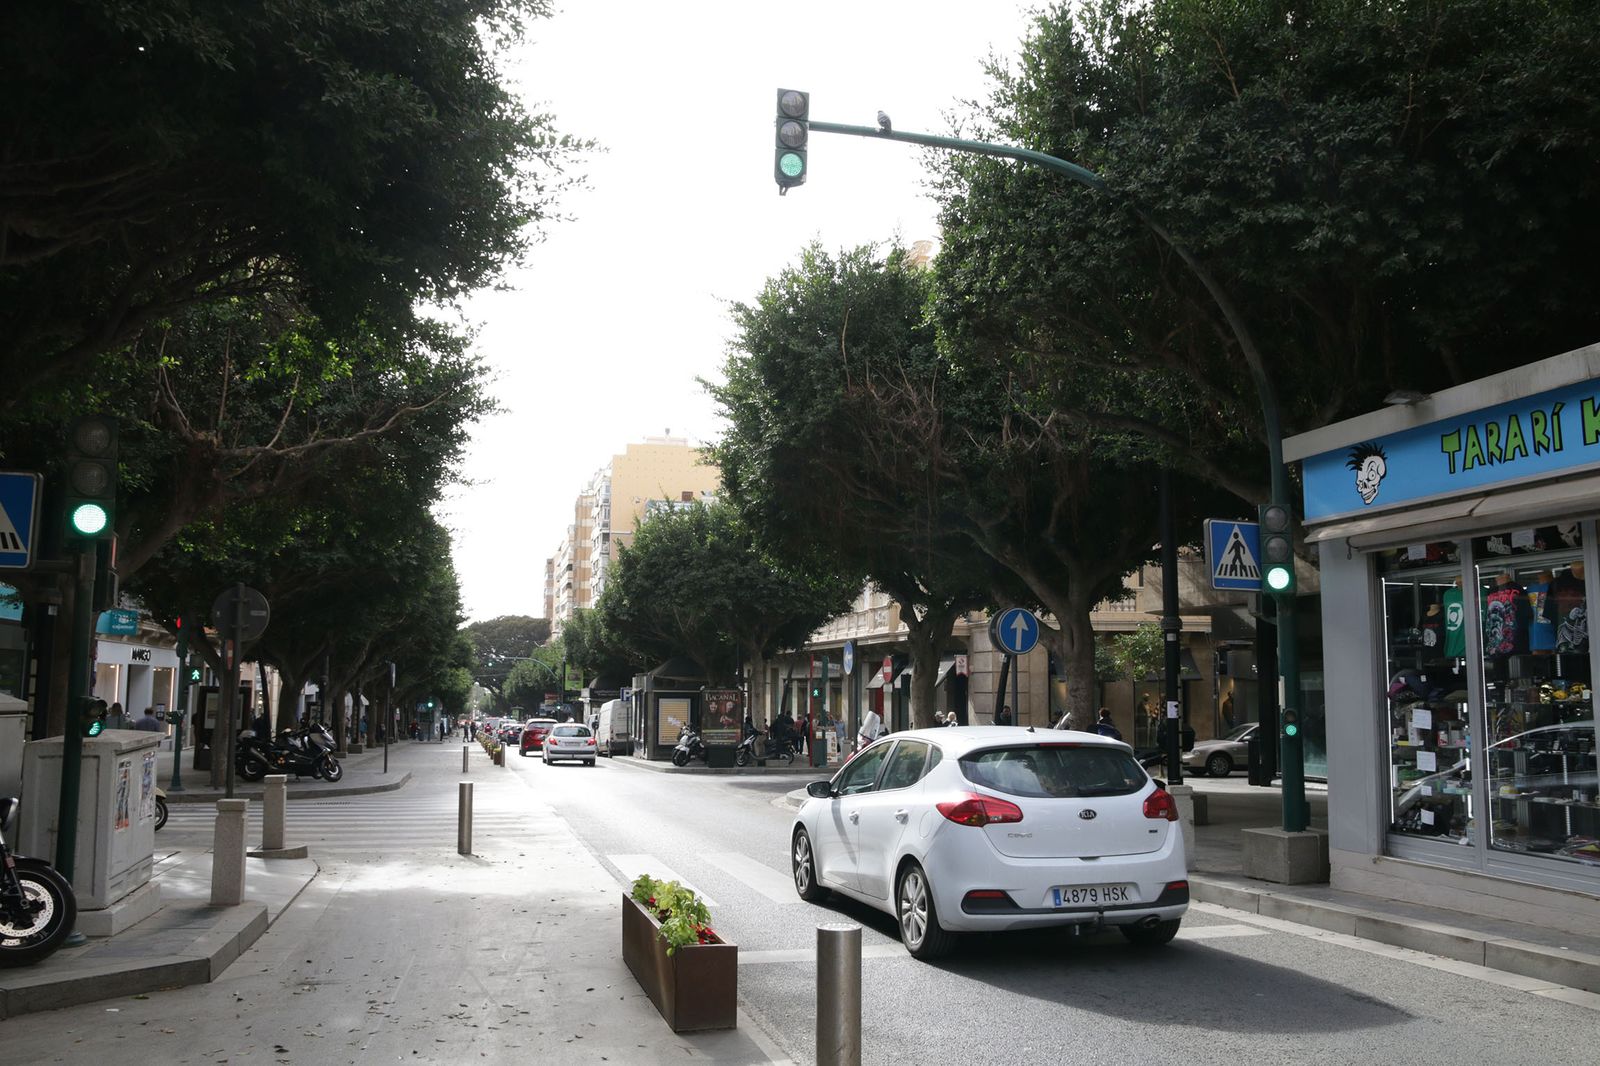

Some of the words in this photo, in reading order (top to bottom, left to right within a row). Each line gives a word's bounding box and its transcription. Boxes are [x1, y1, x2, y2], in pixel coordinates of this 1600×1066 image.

[1441, 401, 1566, 474] TARARÍ
[1063, 888, 1098, 903] 4879
[1102, 887, 1129, 901] HSK
